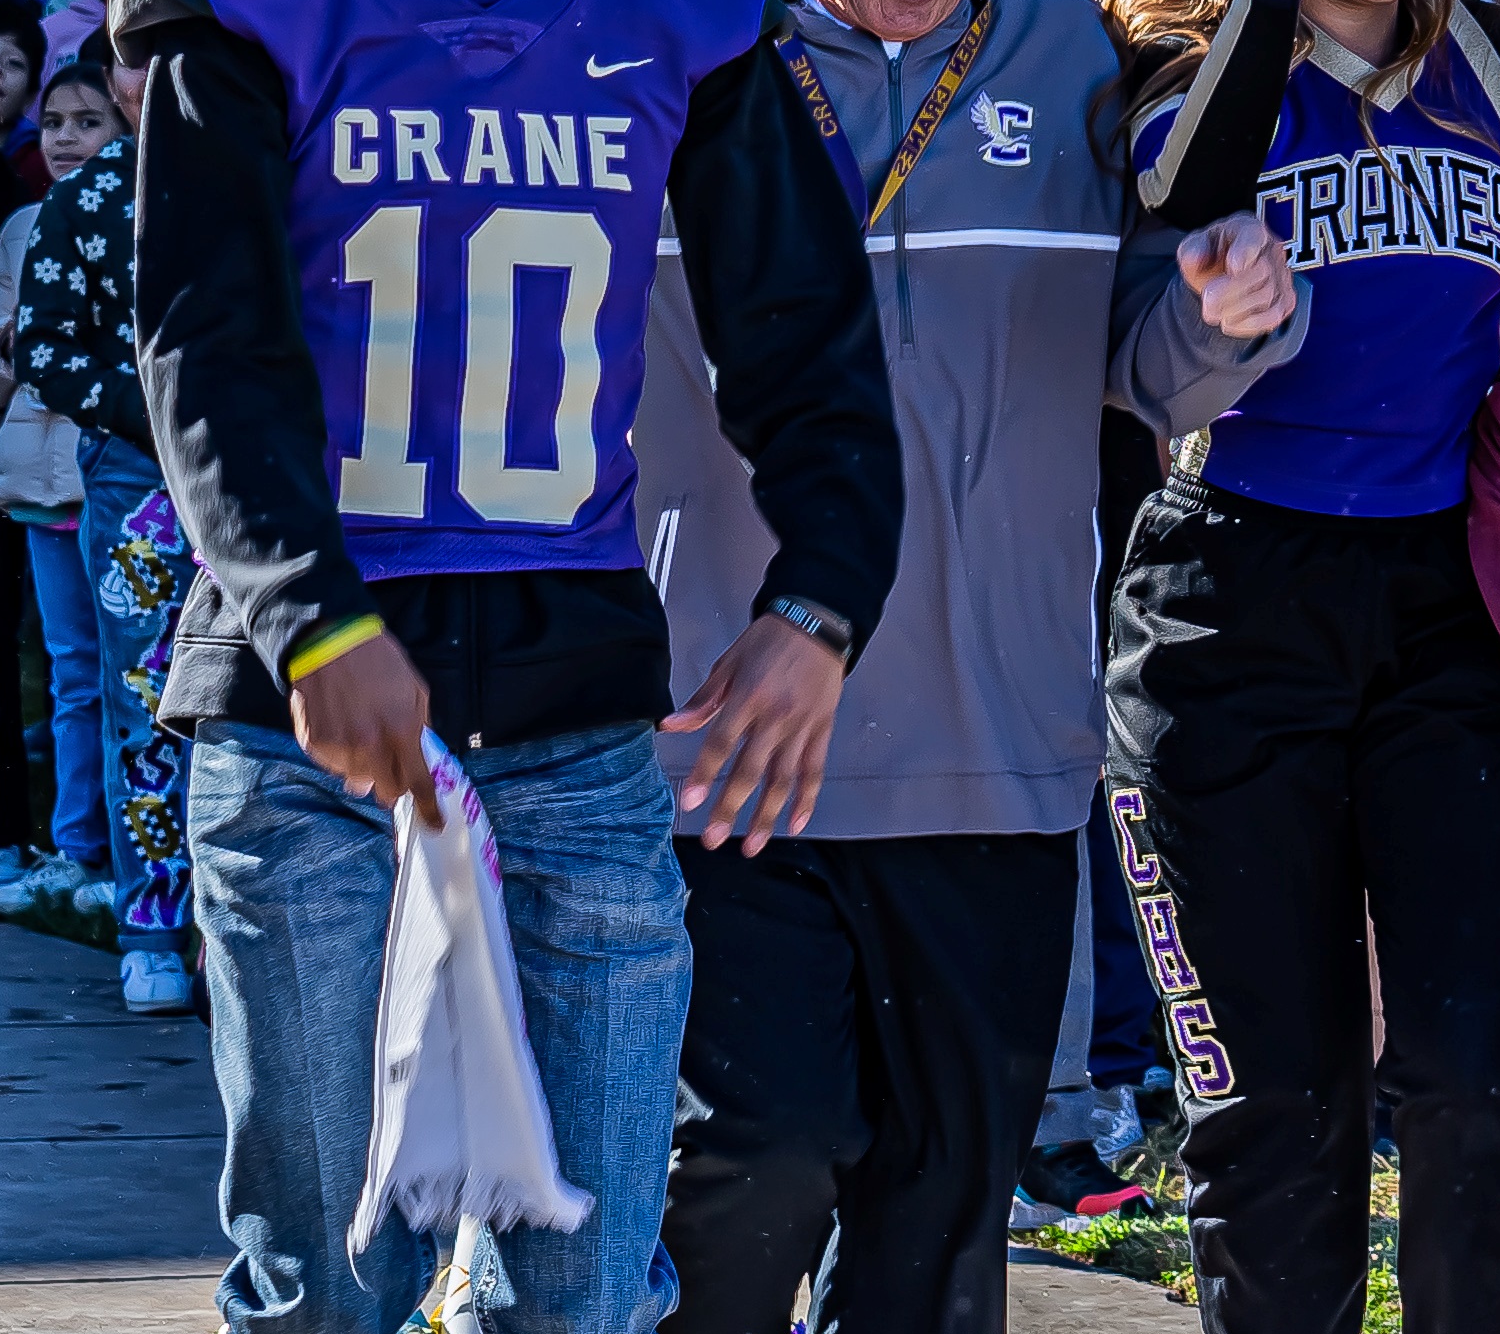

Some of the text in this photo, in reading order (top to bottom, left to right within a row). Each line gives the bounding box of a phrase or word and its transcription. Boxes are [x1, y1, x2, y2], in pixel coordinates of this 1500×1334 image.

[332, 107, 632, 192] CRANE
[789, 53, 838, 139] CRANE
[337, 205, 613, 526] 10
[1110, 786, 1236, 1098] CHS
